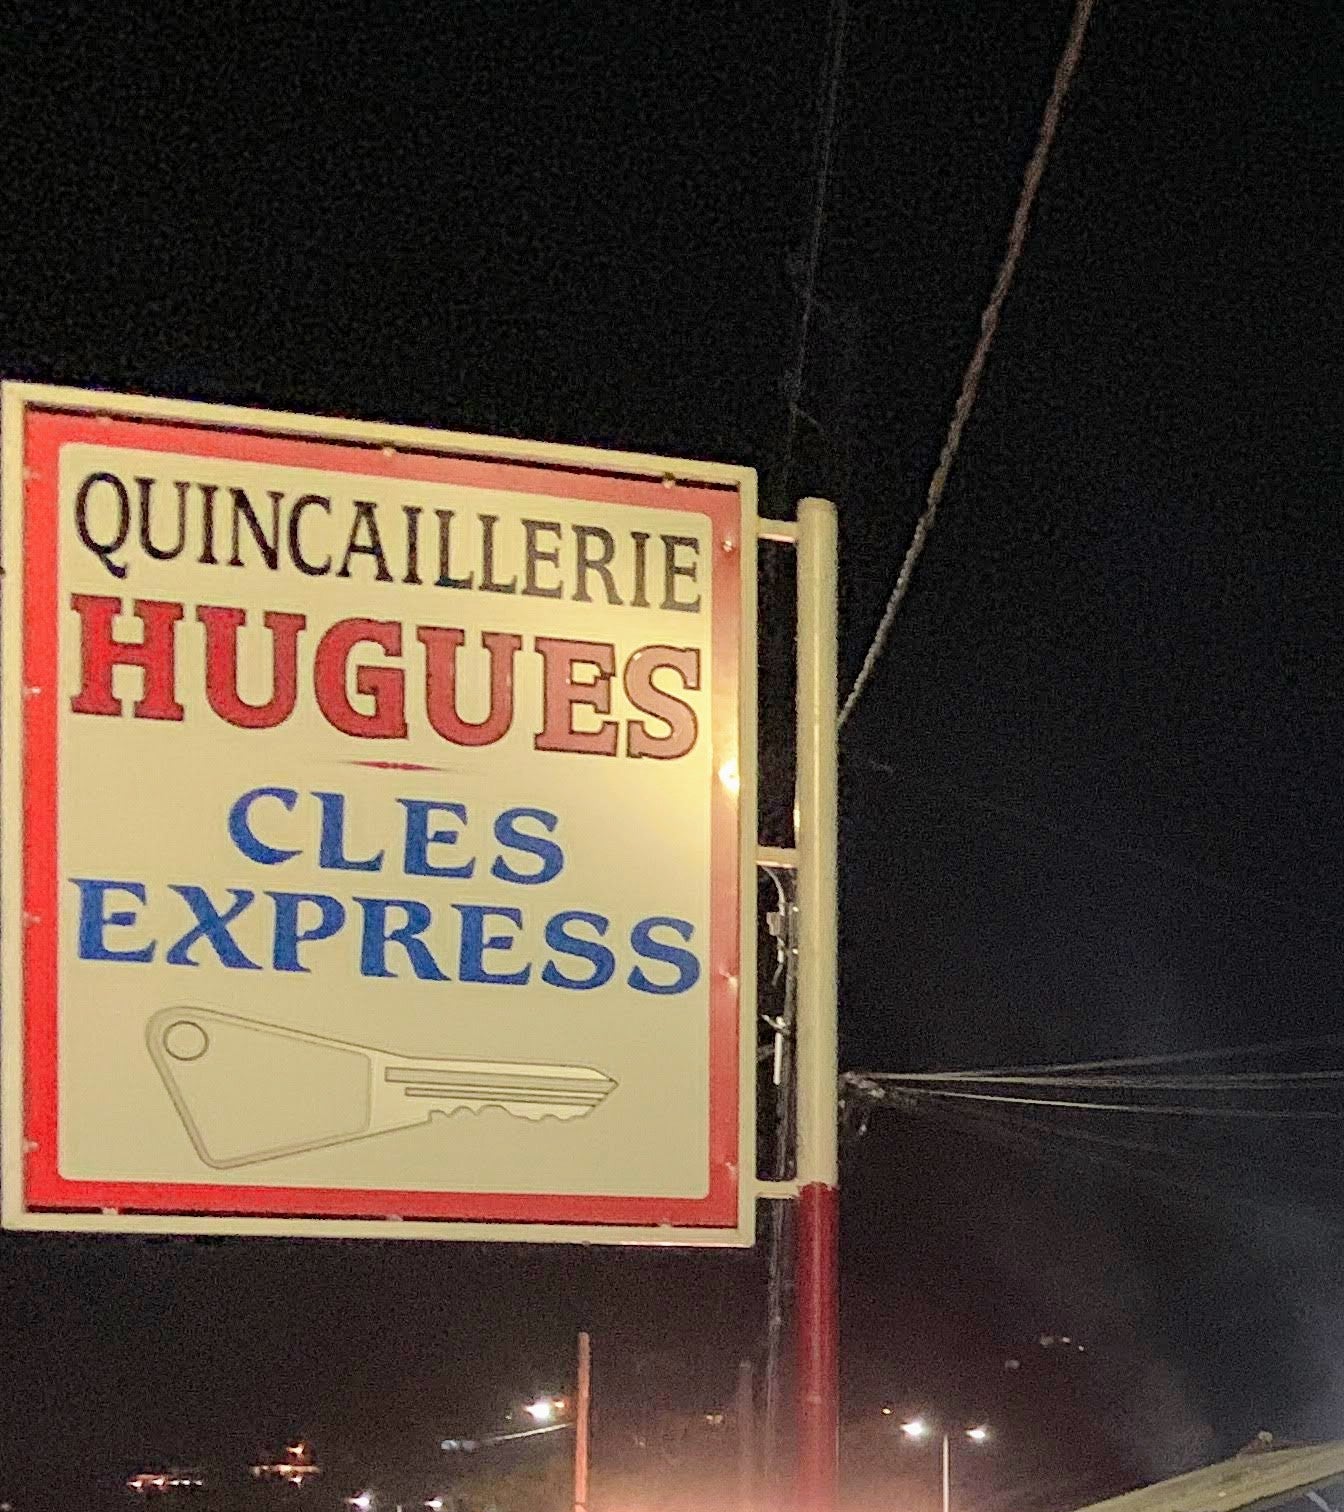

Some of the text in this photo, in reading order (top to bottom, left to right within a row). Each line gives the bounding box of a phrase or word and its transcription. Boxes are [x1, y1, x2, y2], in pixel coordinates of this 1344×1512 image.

[74, 472, 702, 613] QUINCAILLERIE
[70, 594, 702, 759] HUGUES
[227, 786, 565, 885] CLES
[68, 878, 701, 995] EXPRESS
